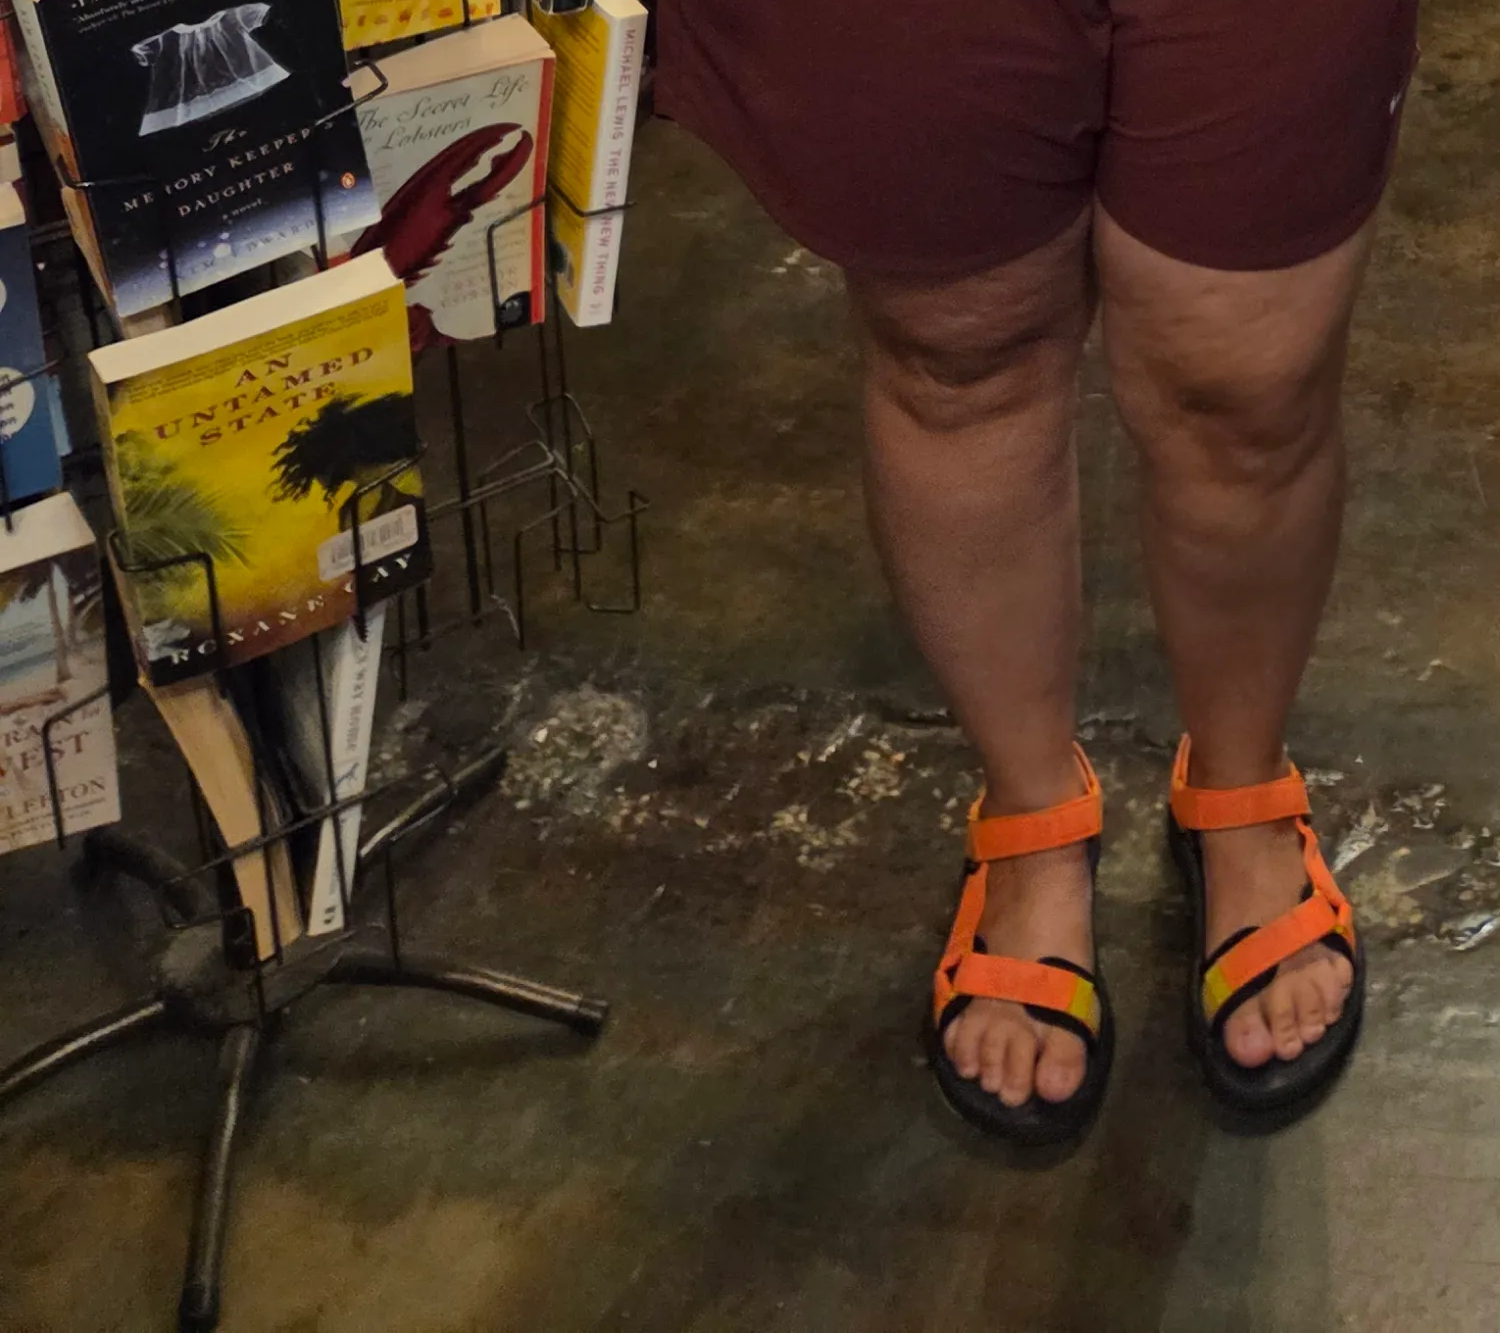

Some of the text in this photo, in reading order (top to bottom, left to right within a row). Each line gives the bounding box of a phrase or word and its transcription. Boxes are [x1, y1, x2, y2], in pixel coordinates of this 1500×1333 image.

[615, 27, 636, 93] MICHAEL
[610, 95, 628, 141] LEWIS
[178, 160, 296, 218] DAUGHTER
[152, 346, 377, 442] UNTAMED
[233, 352, 295, 390] AN
[198, 380, 337, 448] STATE
